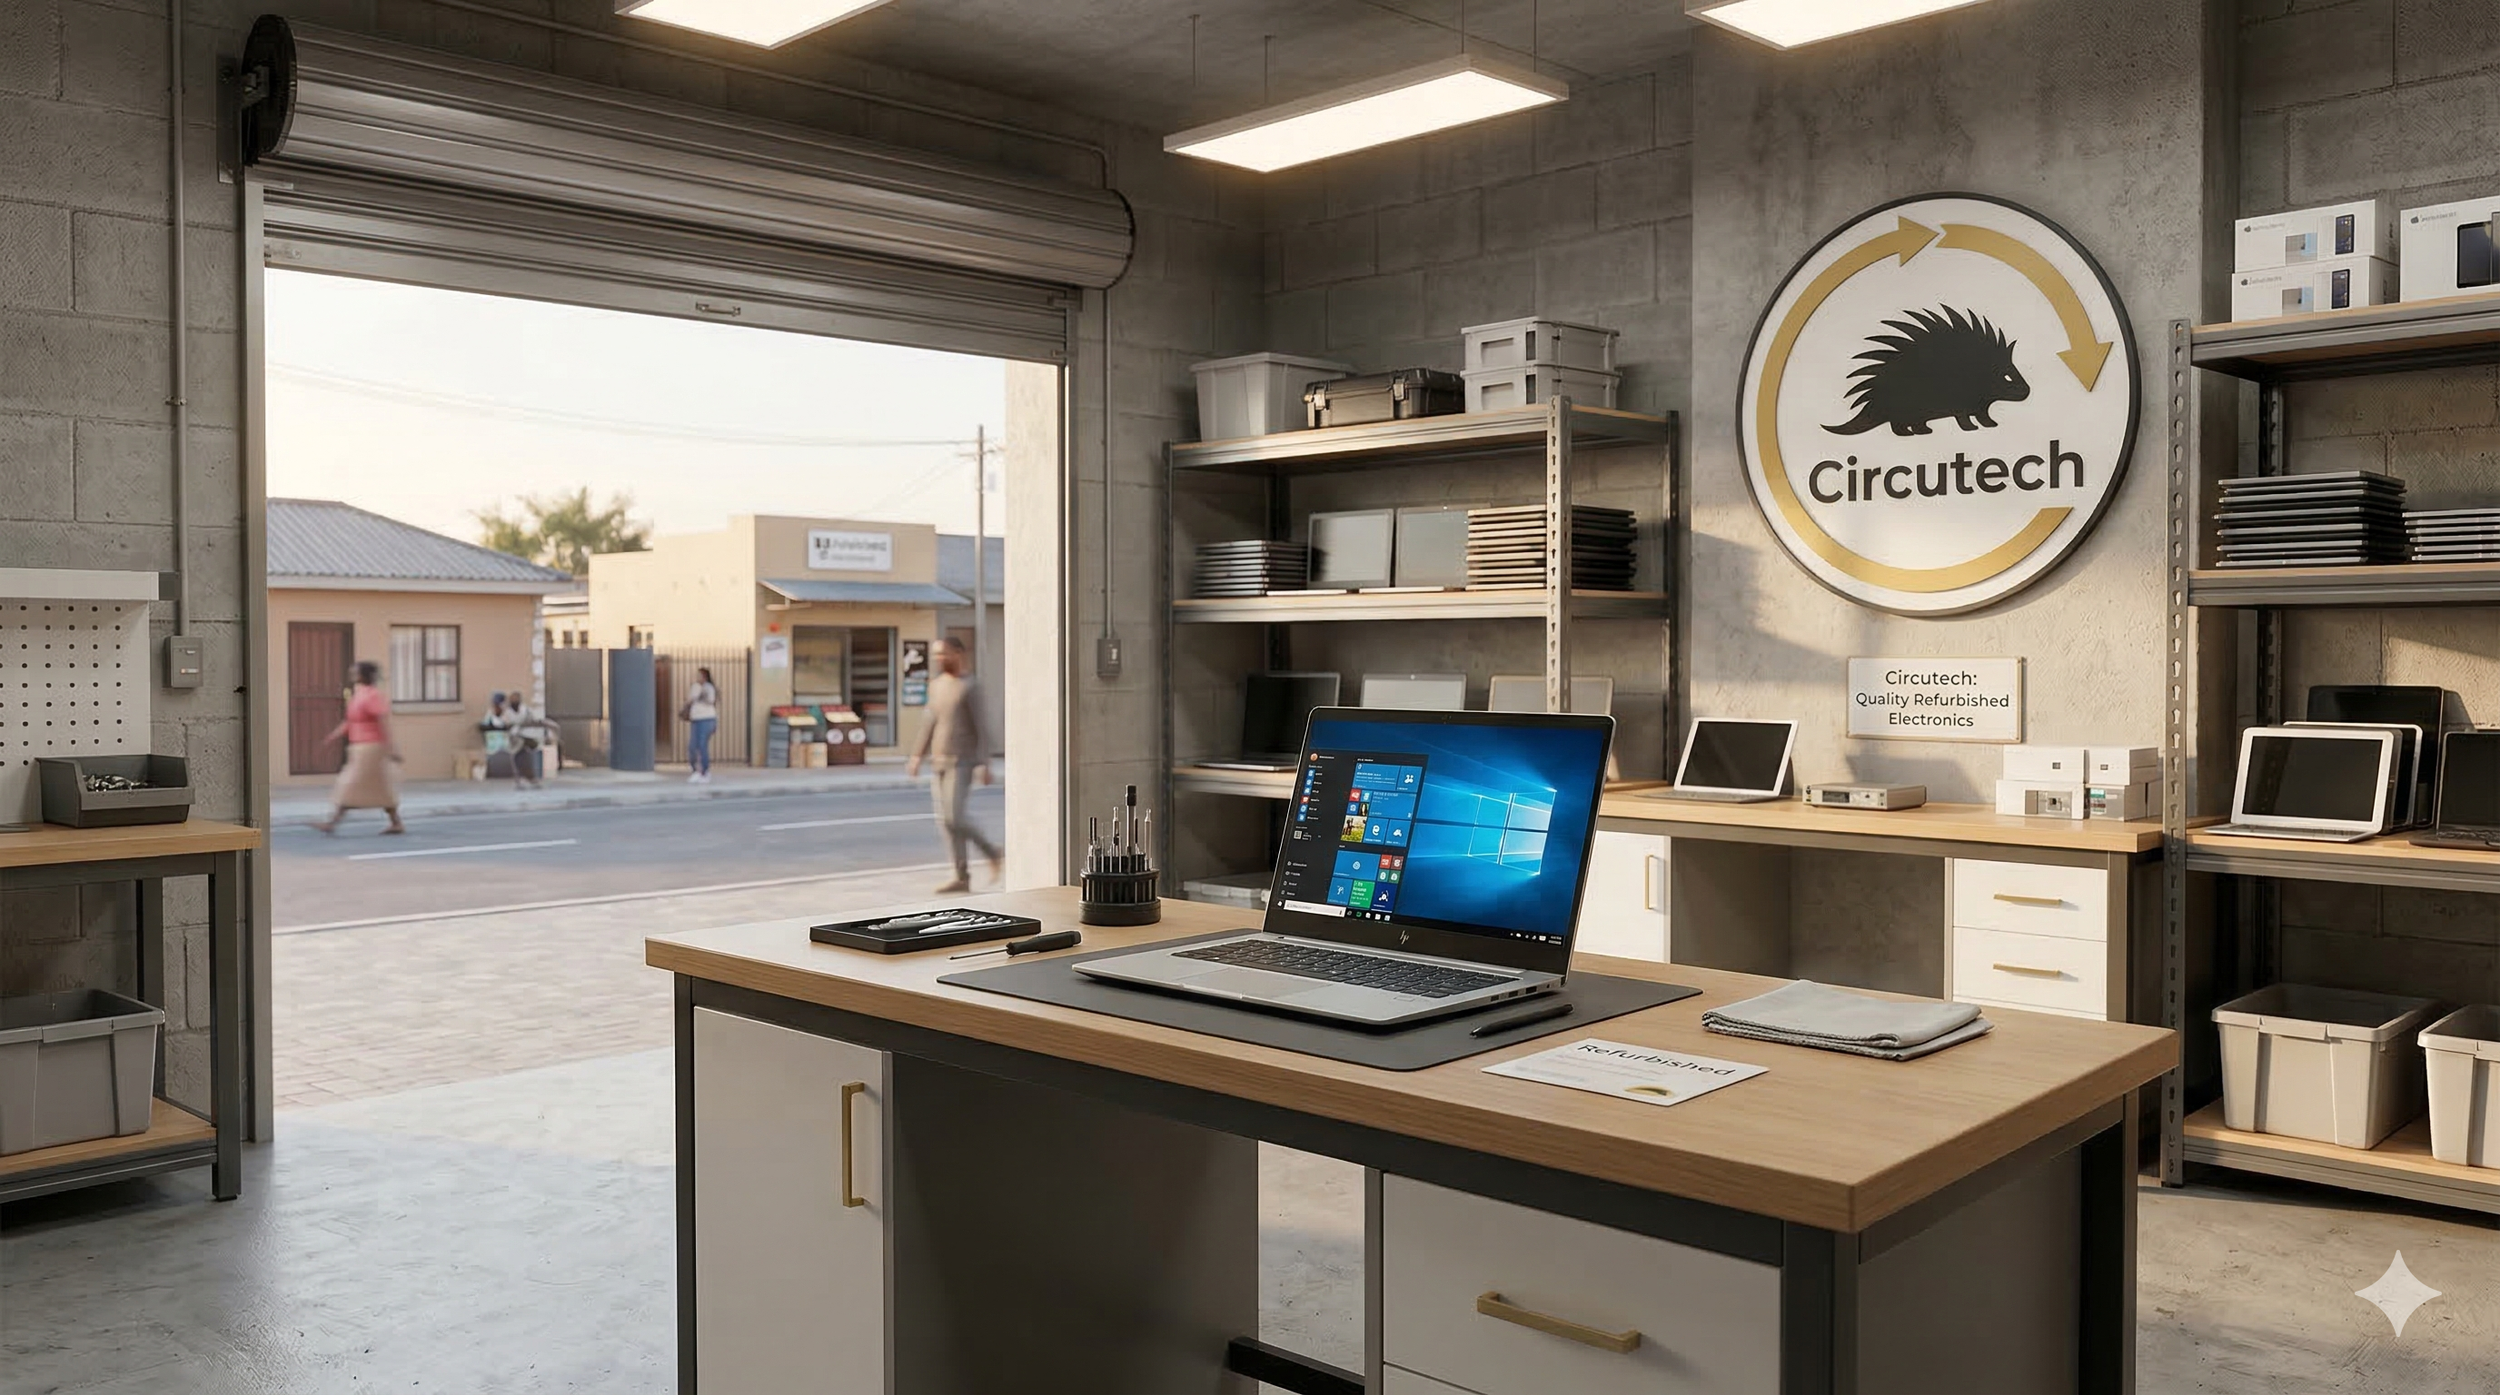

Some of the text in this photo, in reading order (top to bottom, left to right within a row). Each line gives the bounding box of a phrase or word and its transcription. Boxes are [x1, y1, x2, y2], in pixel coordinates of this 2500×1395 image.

[1808, 440, 2084, 504] Circutech
[1885, 669, 1977, 686] Circutech:
[1855, 692, 2009, 709] Quality Refurbished
[1889, 712, 1974, 727] Electronics
[1576, 1043, 1737, 1077] Refurbished
